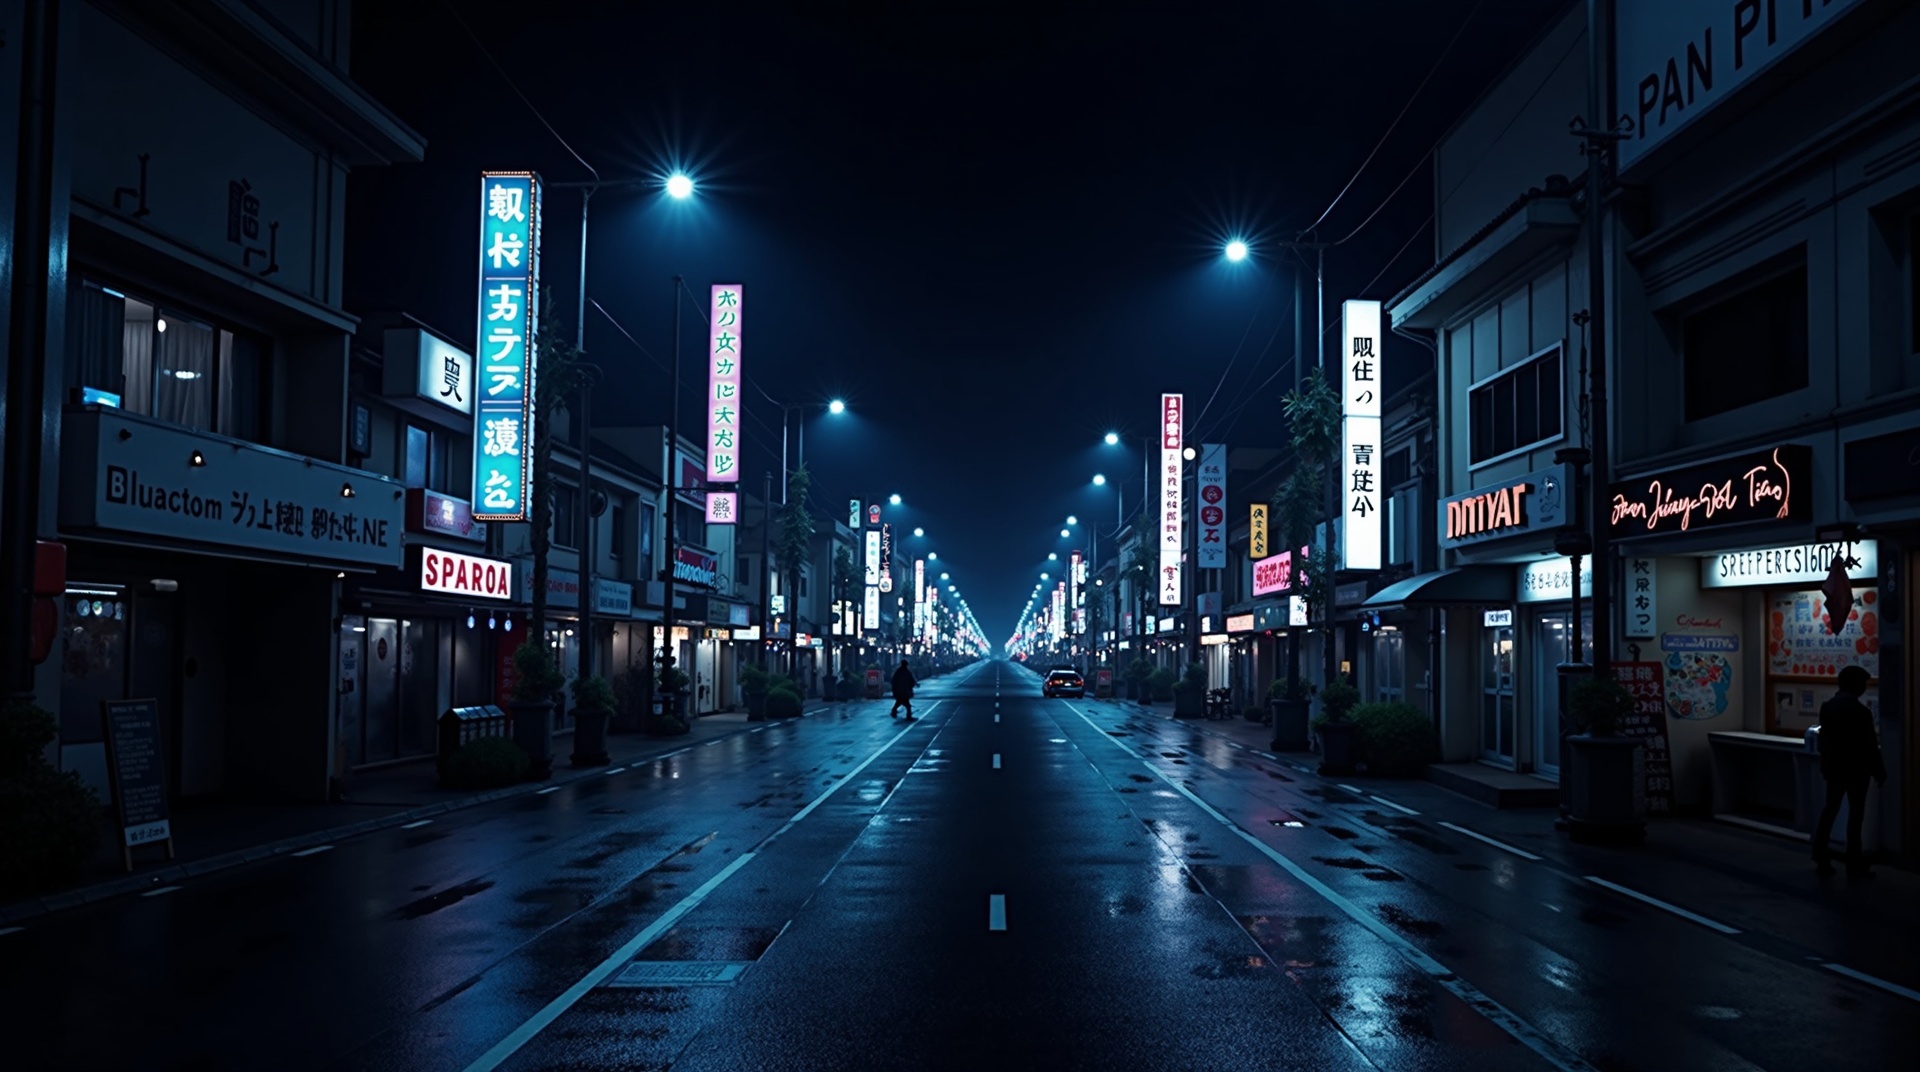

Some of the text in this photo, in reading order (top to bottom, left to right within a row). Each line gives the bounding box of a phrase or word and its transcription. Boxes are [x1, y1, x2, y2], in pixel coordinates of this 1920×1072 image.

[1639, 27, 1712, 140] PAN
[107, 464, 222, 520] Bluactom
[425, 553, 508, 596] SPAROA
